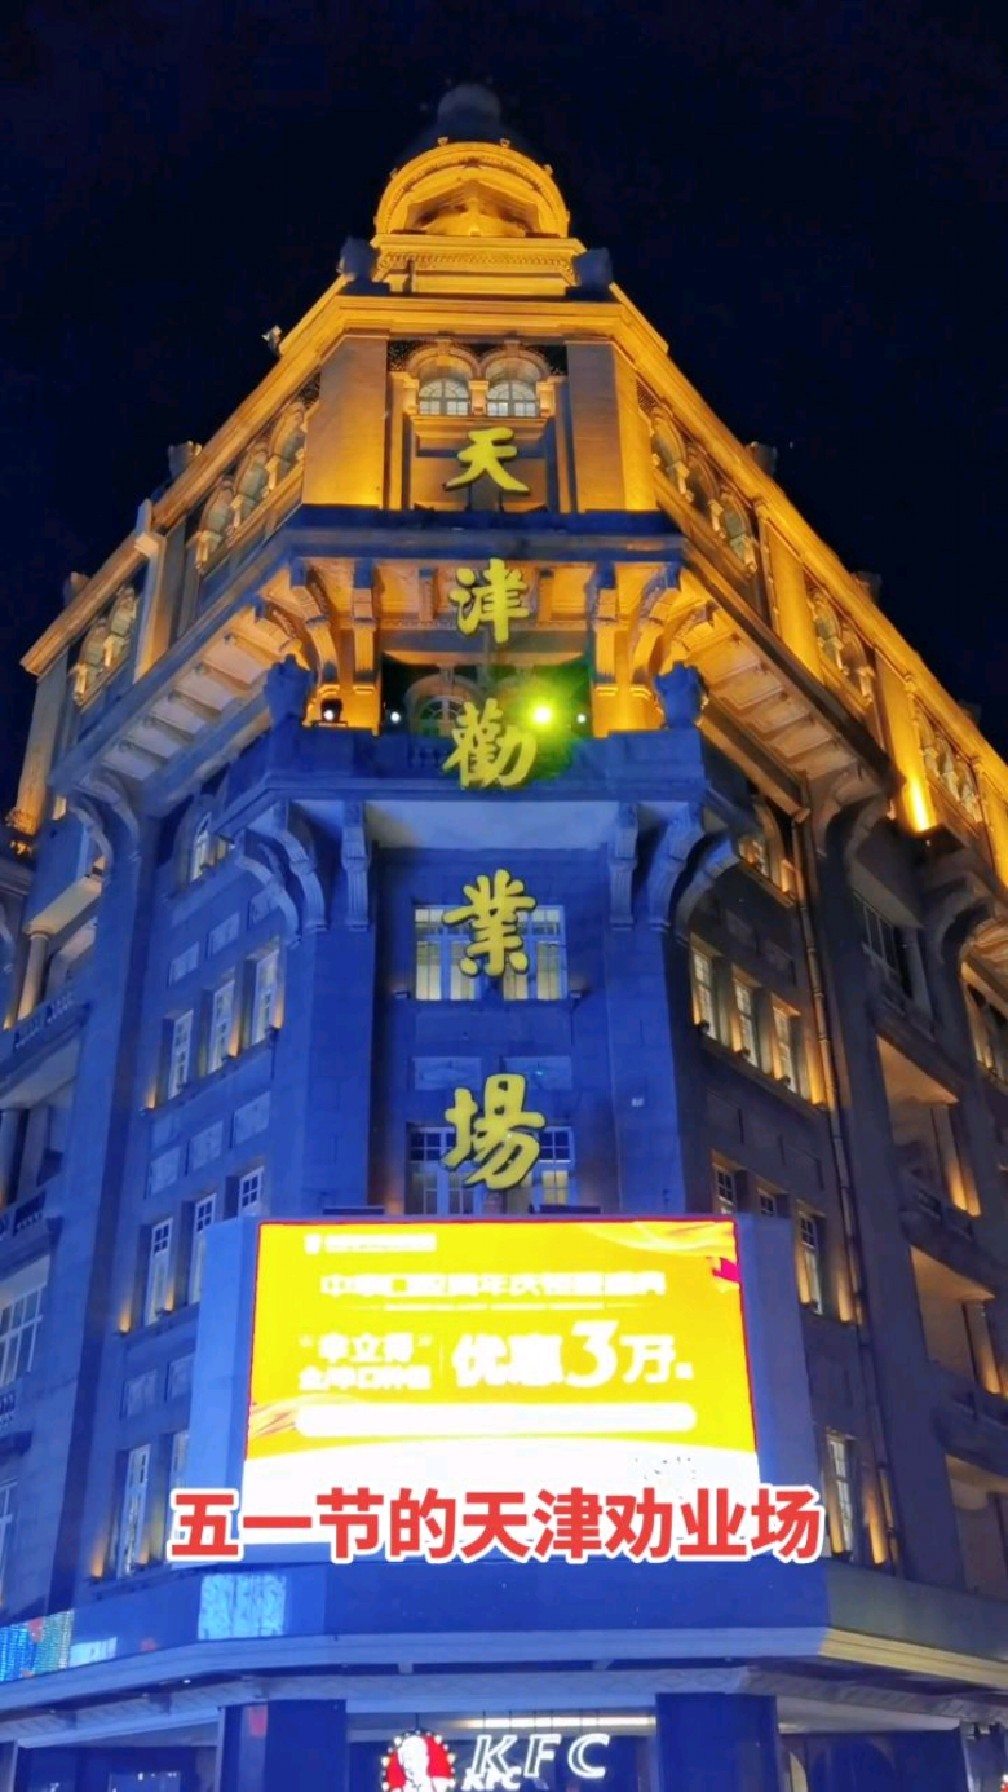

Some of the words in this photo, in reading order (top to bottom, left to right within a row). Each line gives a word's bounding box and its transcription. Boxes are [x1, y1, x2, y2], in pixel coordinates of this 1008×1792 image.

[443, 427, 546, 1190] 天津勸業場
[472, 1733, 611, 1779] KFC
